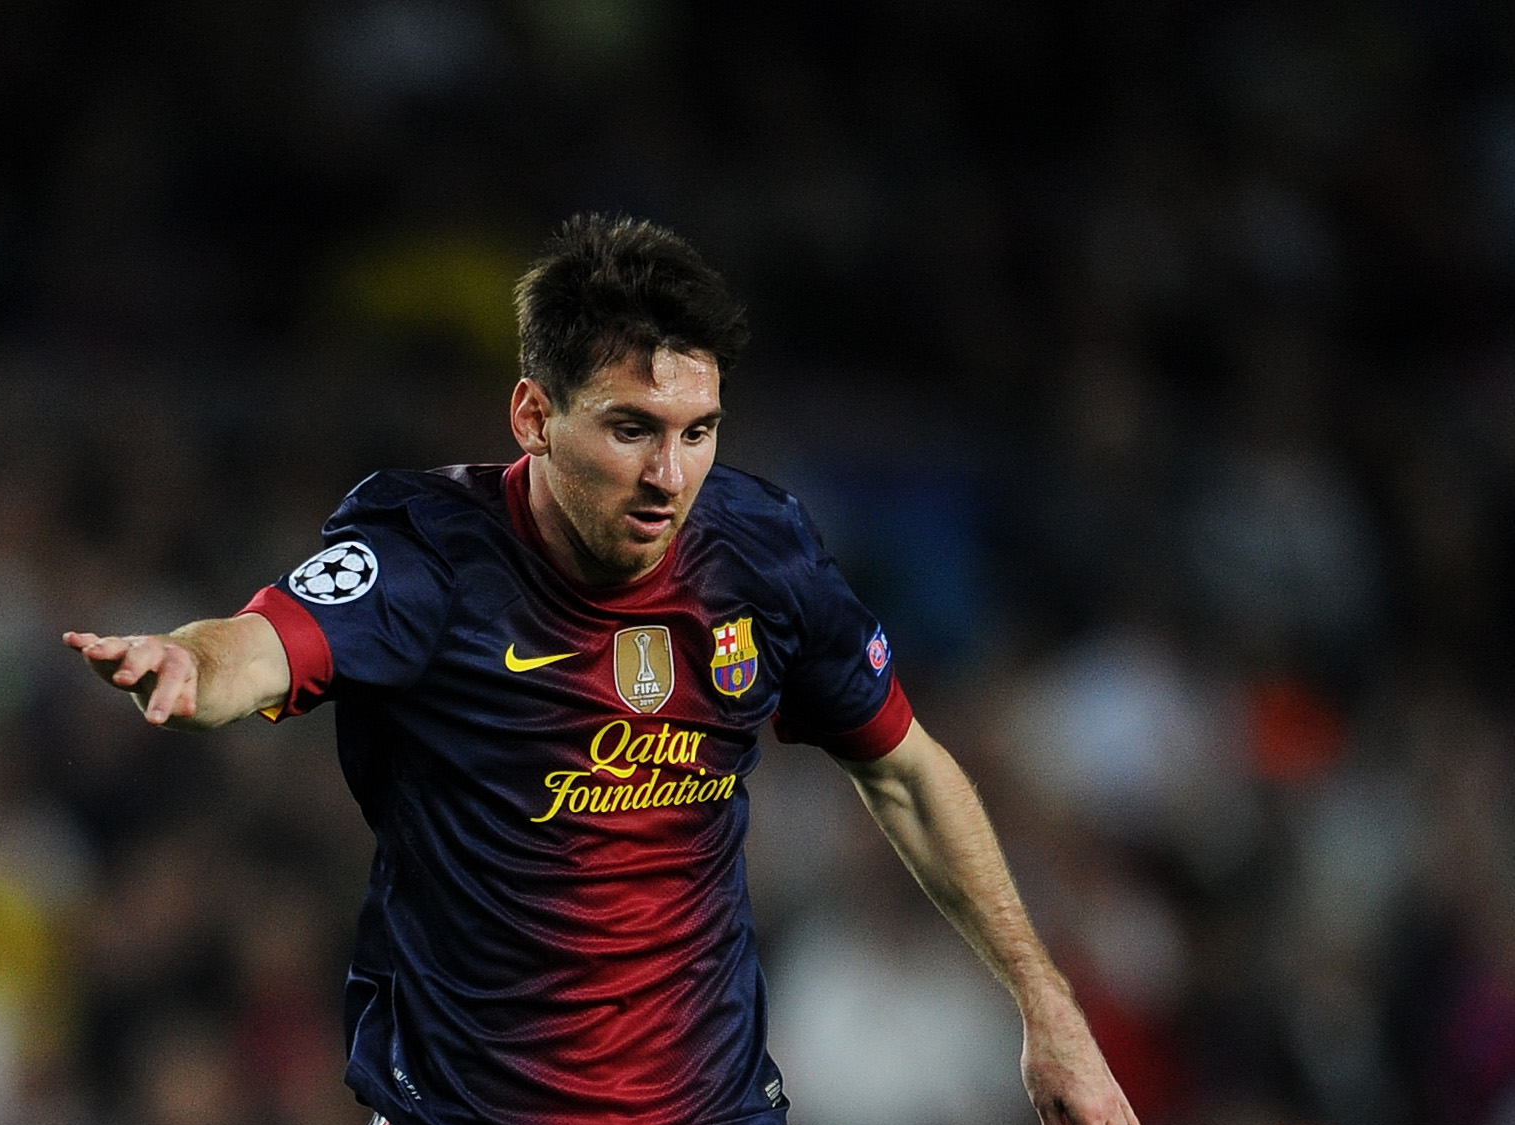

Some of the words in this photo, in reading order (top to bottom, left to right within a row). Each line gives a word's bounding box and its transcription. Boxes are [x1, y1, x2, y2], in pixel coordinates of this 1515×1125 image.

[727, 650, 744, 664] FCB
[633, 681, 660, 695] FIFA
[590, 720, 707, 778] Qatar
[530, 768, 736, 823] Foundation
